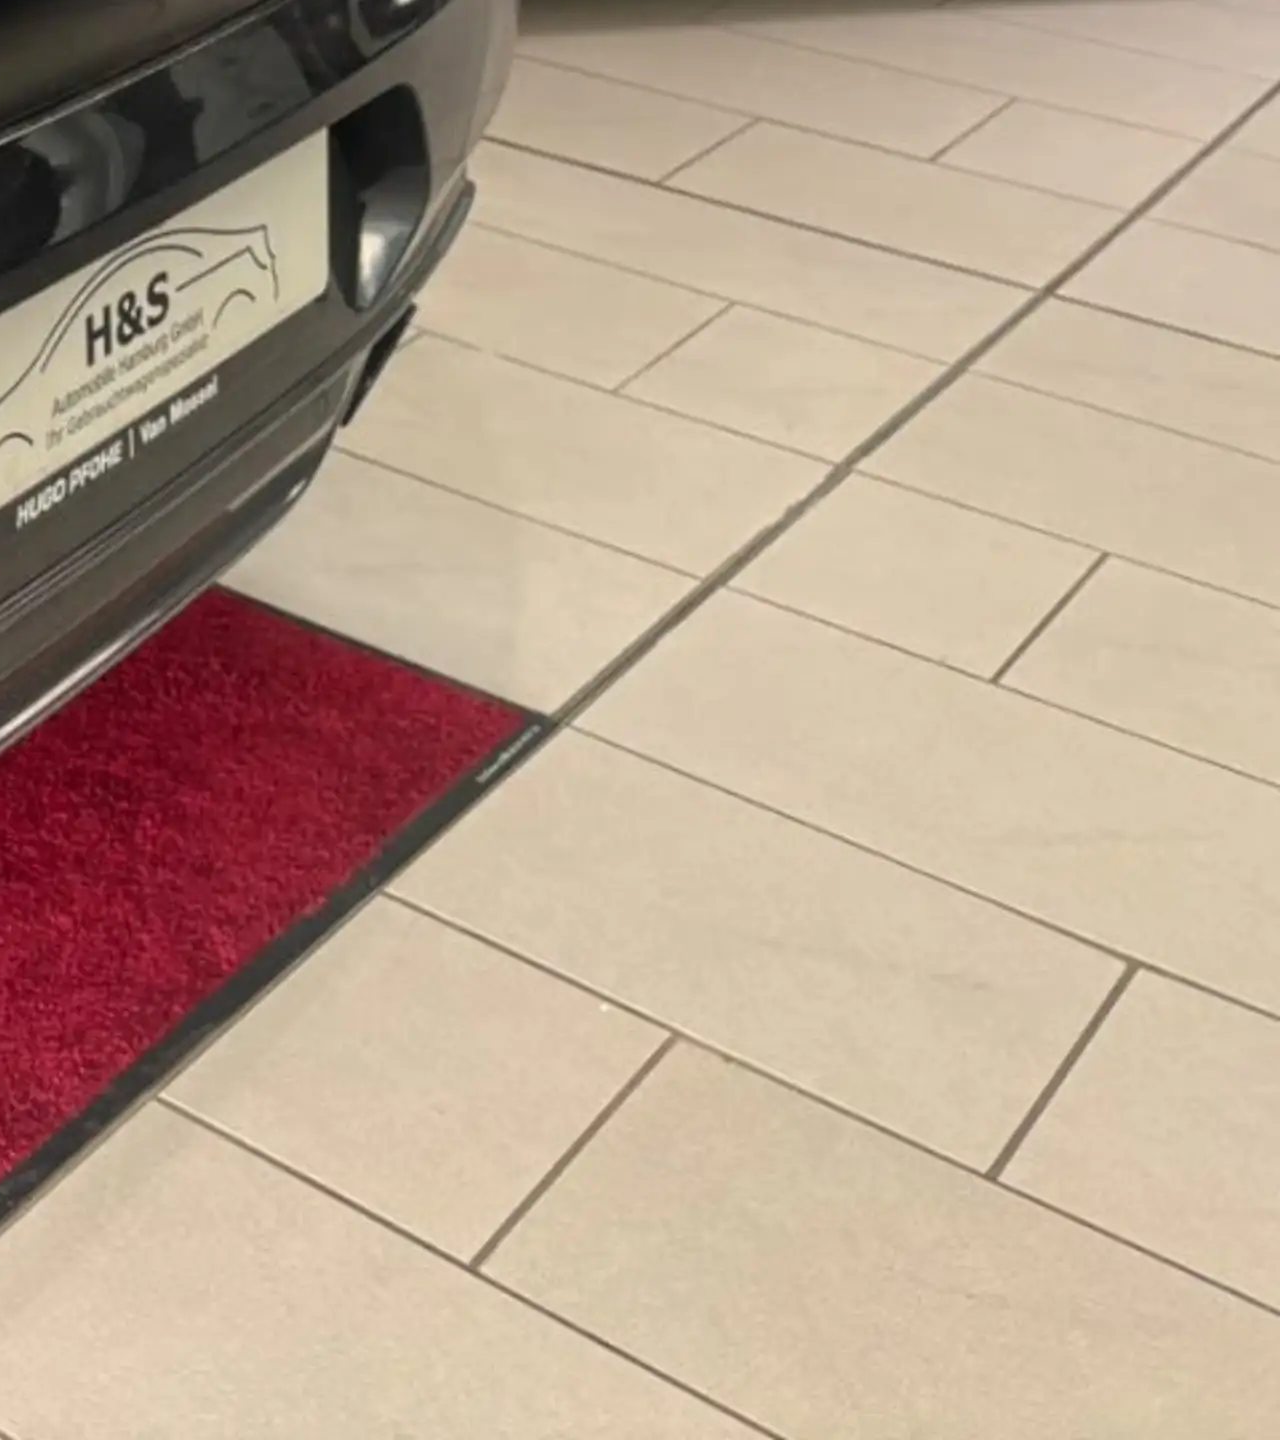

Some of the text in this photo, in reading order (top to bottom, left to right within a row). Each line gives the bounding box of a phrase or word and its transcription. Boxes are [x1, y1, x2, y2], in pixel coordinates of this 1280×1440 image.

[85, 271, 170, 368] H&S
[15, 477, 67, 532] HUGO
[68, 439, 124, 495] PFOHE
[139, 414, 167, 446] Van
